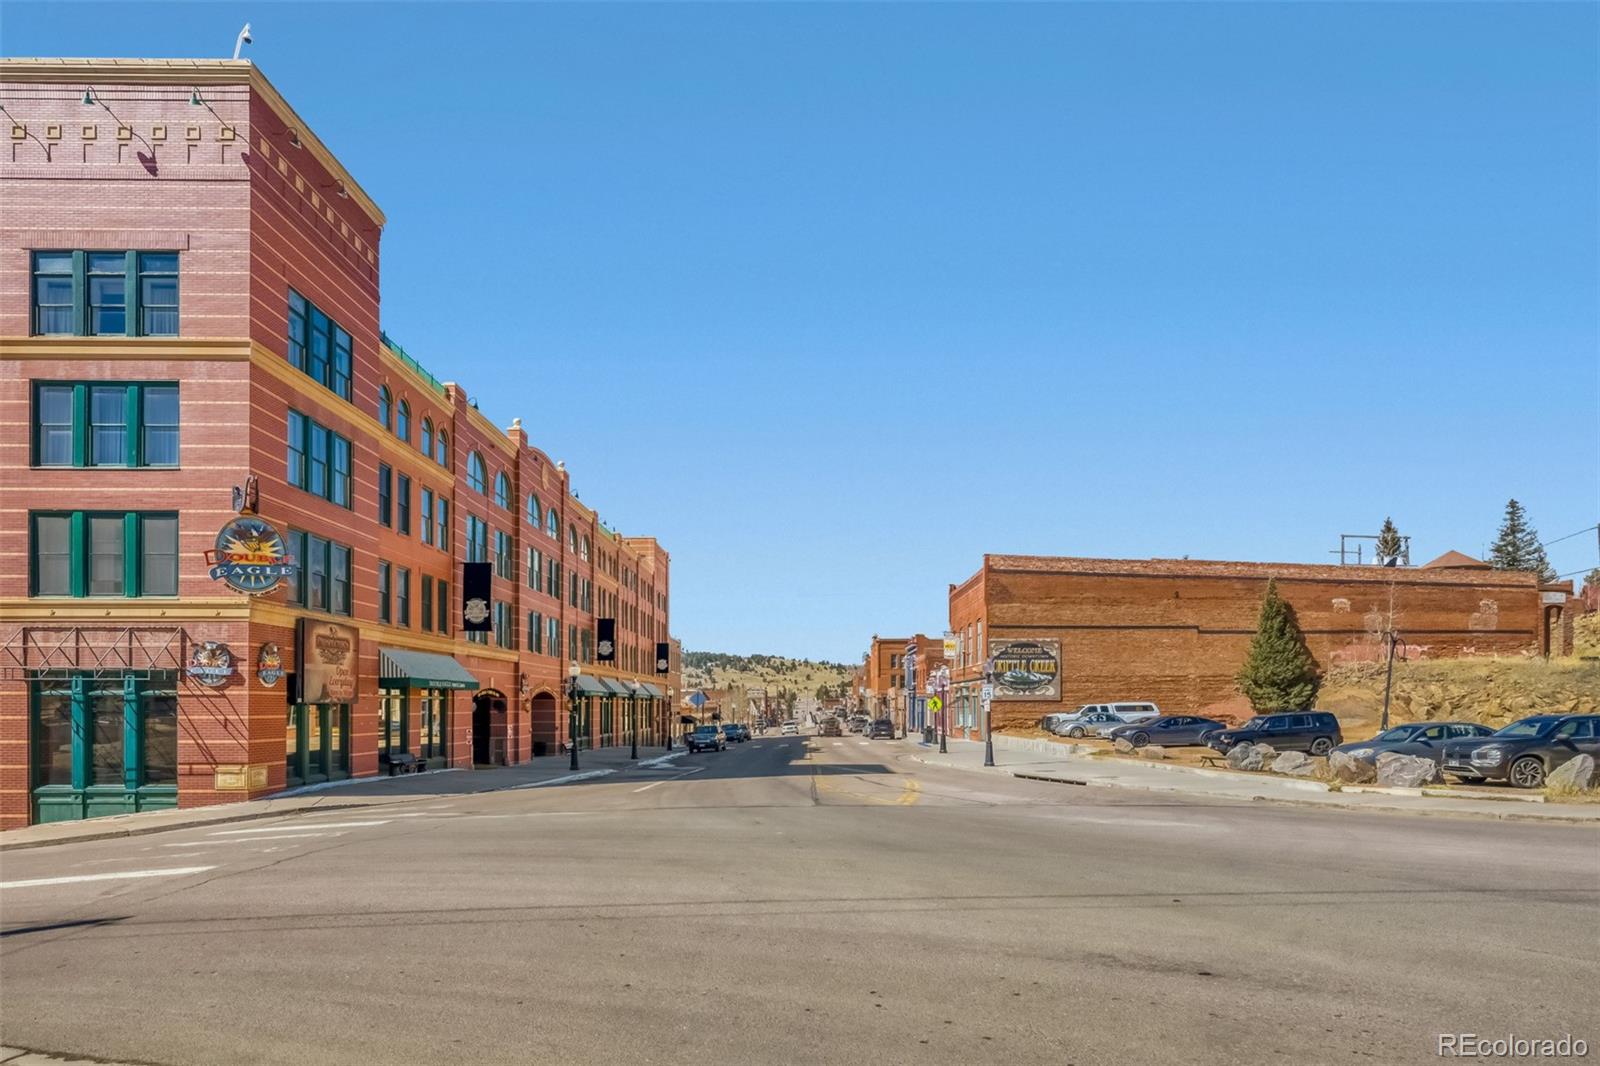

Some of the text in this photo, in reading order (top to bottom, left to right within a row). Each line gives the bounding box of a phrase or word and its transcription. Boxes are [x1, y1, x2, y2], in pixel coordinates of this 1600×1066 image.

[216, 565, 292, 577] EAGLE
[993, 659, 1056, 673] CRIPPLE CREEK
